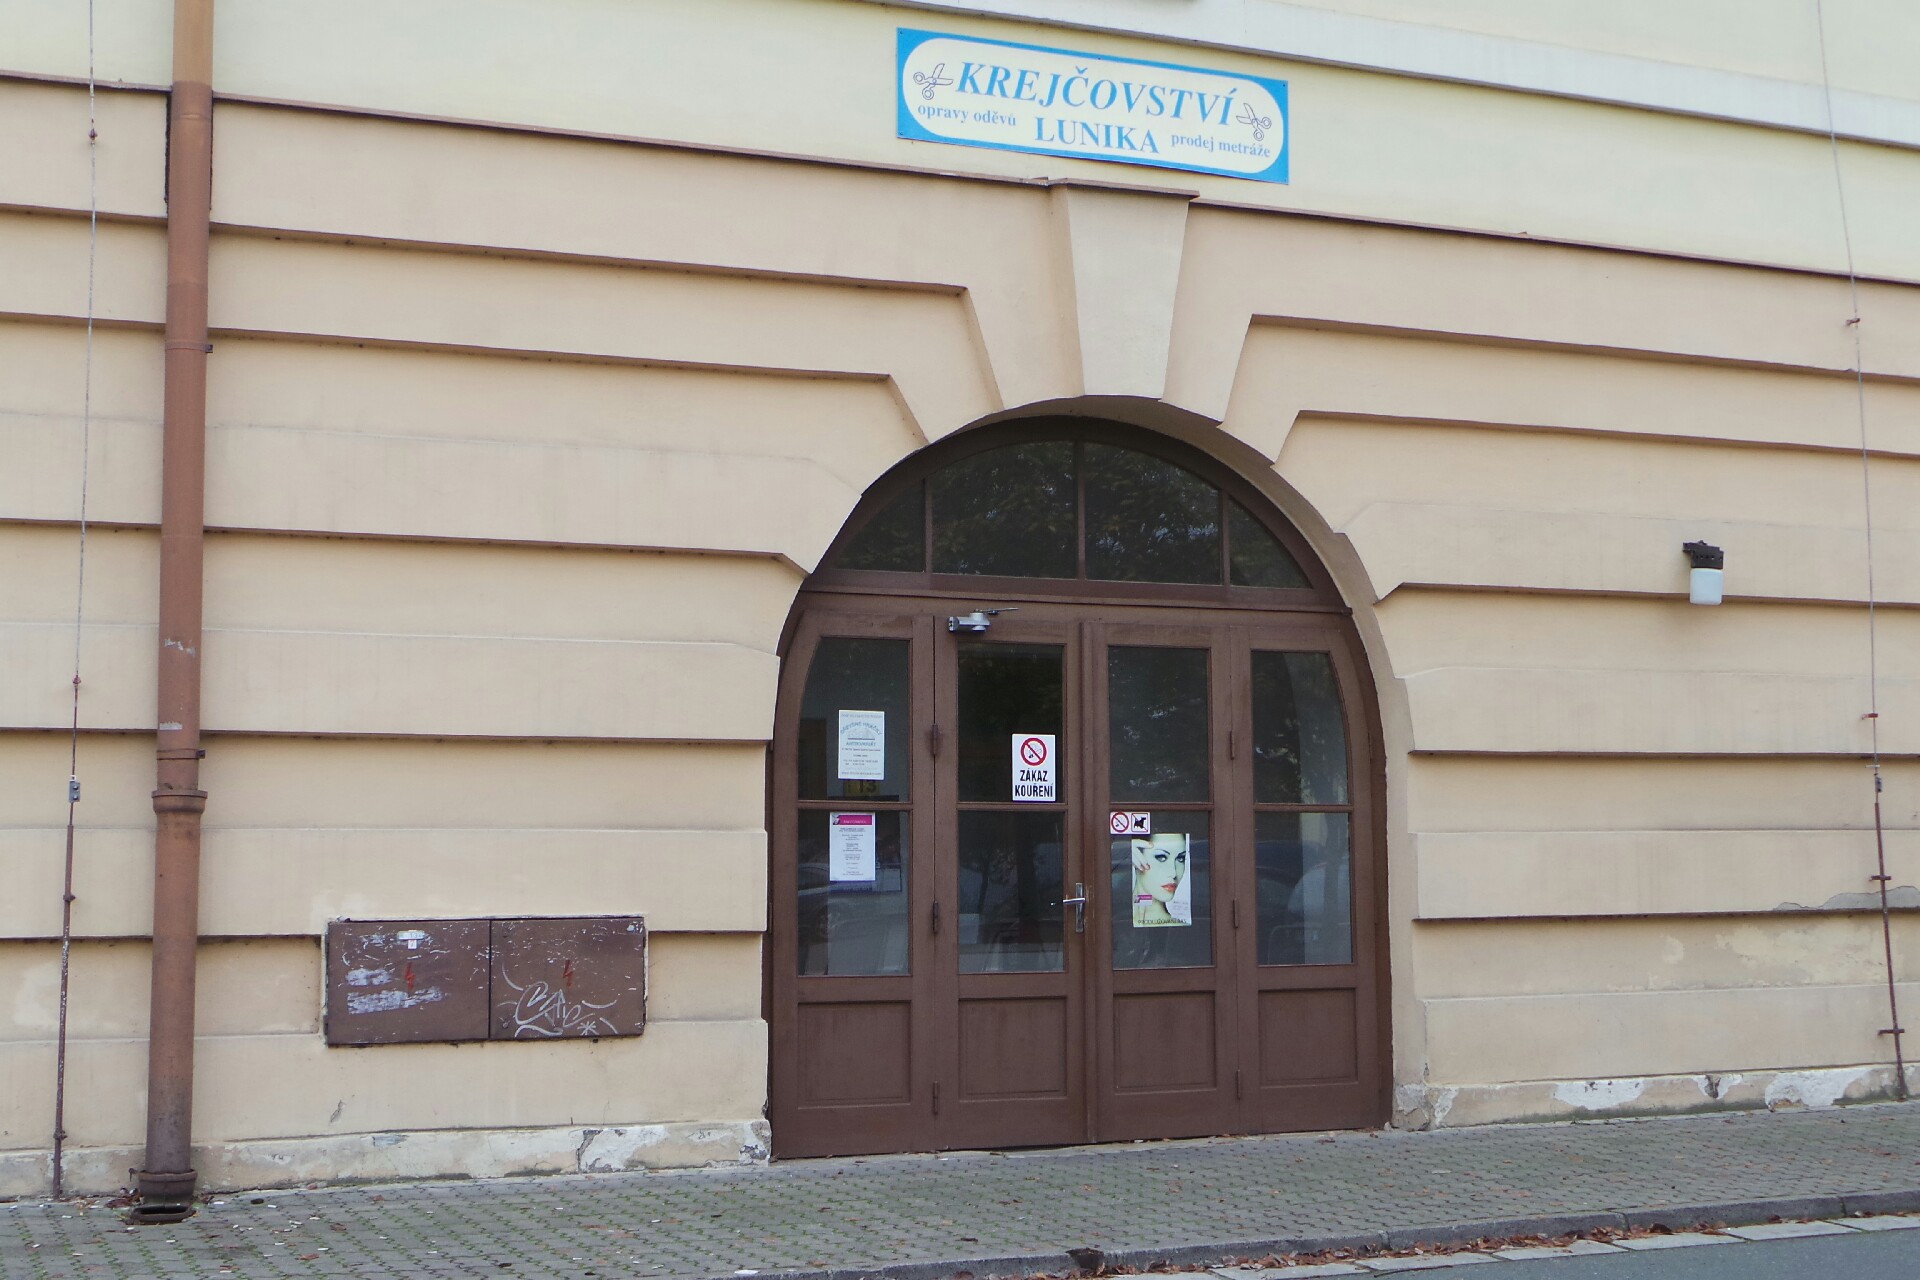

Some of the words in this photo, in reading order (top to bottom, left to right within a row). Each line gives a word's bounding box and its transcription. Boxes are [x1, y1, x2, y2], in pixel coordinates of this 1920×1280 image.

[955, 61, 1238, 126] KREJČOVSTVÍ
[917, 103, 969, 124] opravy
[1034, 116, 1160, 155] LUNIKA
[1170, 133, 1215, 153] prodej
[1218, 137, 1271, 159] metráže
[1019, 767, 1048, 782] ZÁKAZ
[1014, 782, 1054, 798] KOUŘENÍ
